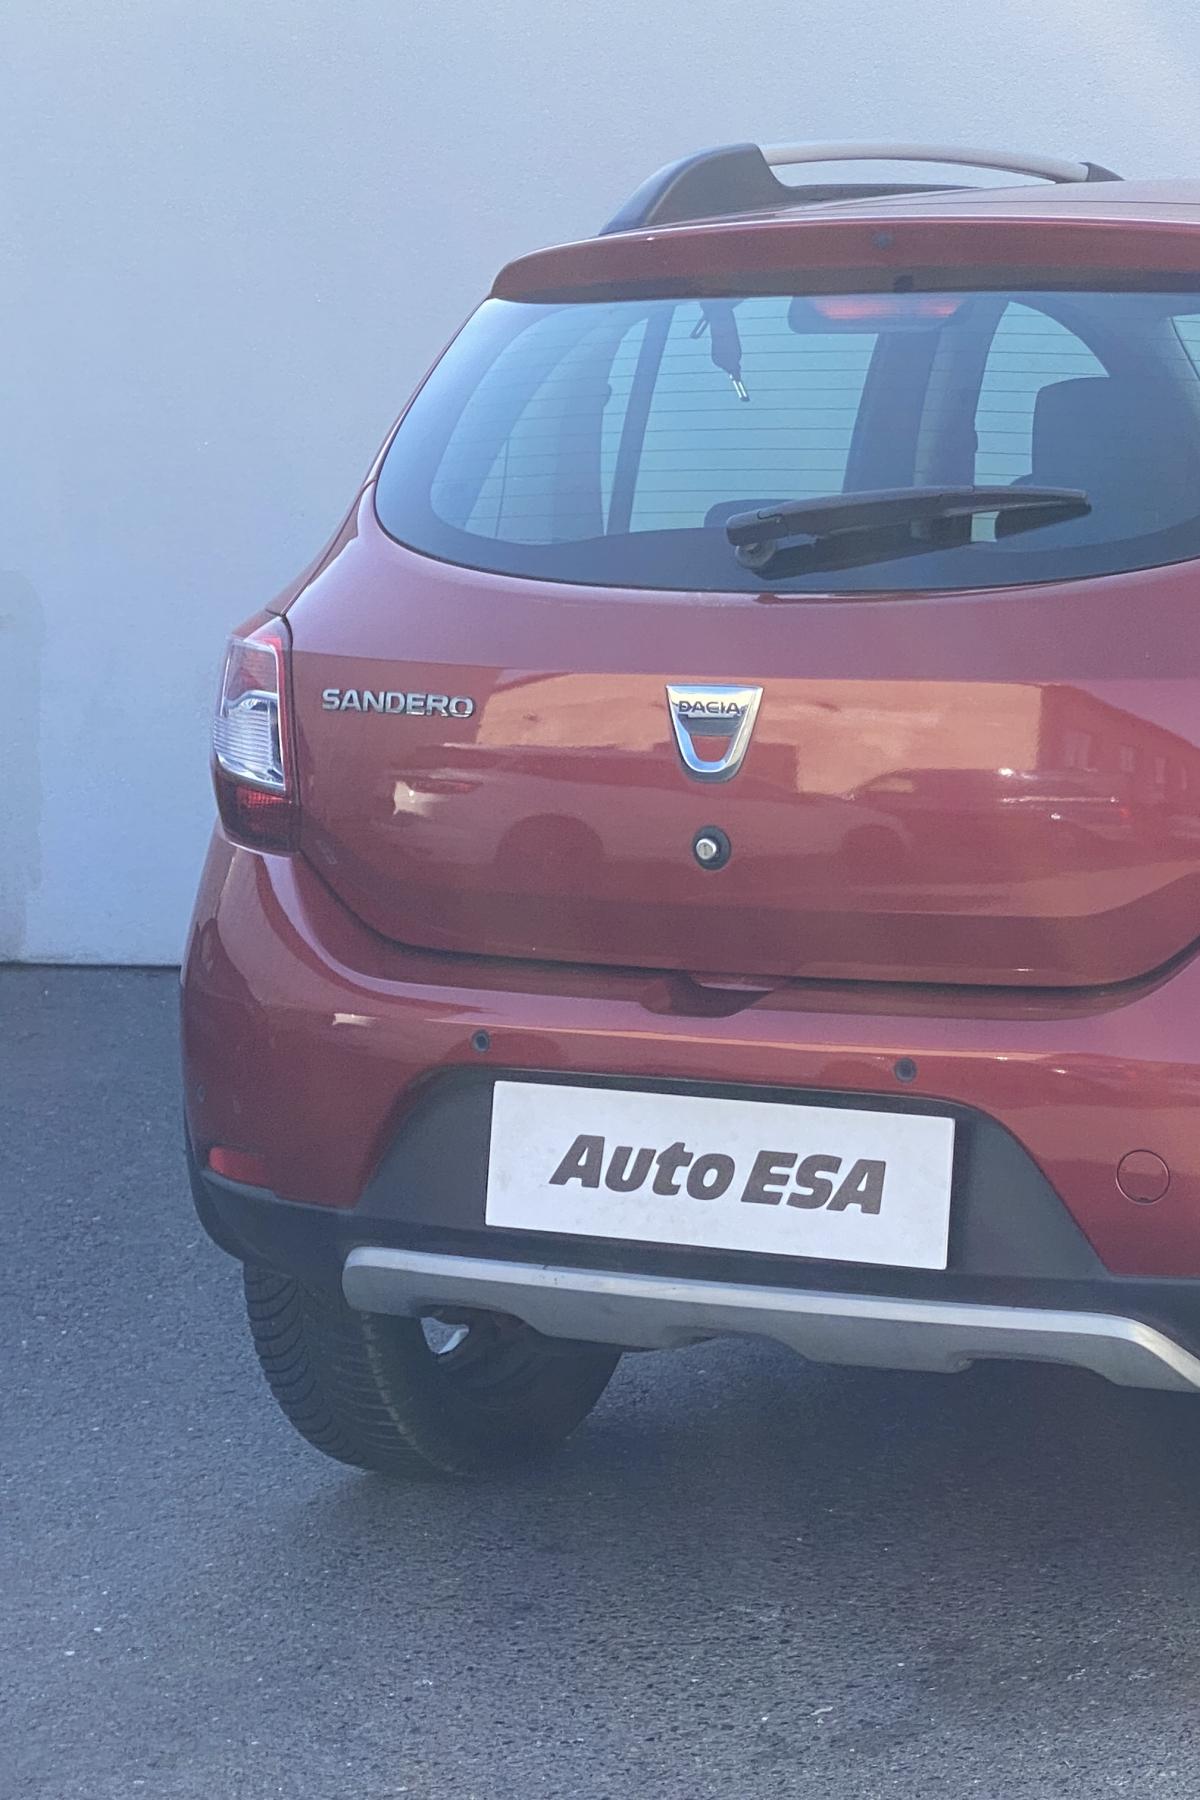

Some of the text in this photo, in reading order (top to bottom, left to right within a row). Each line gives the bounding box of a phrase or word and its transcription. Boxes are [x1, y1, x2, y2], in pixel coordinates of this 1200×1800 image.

[322, 688, 475, 718] SANDERO
[678, 700, 741, 715] DACIA
[548, 1134, 887, 1215] Auto ESA
